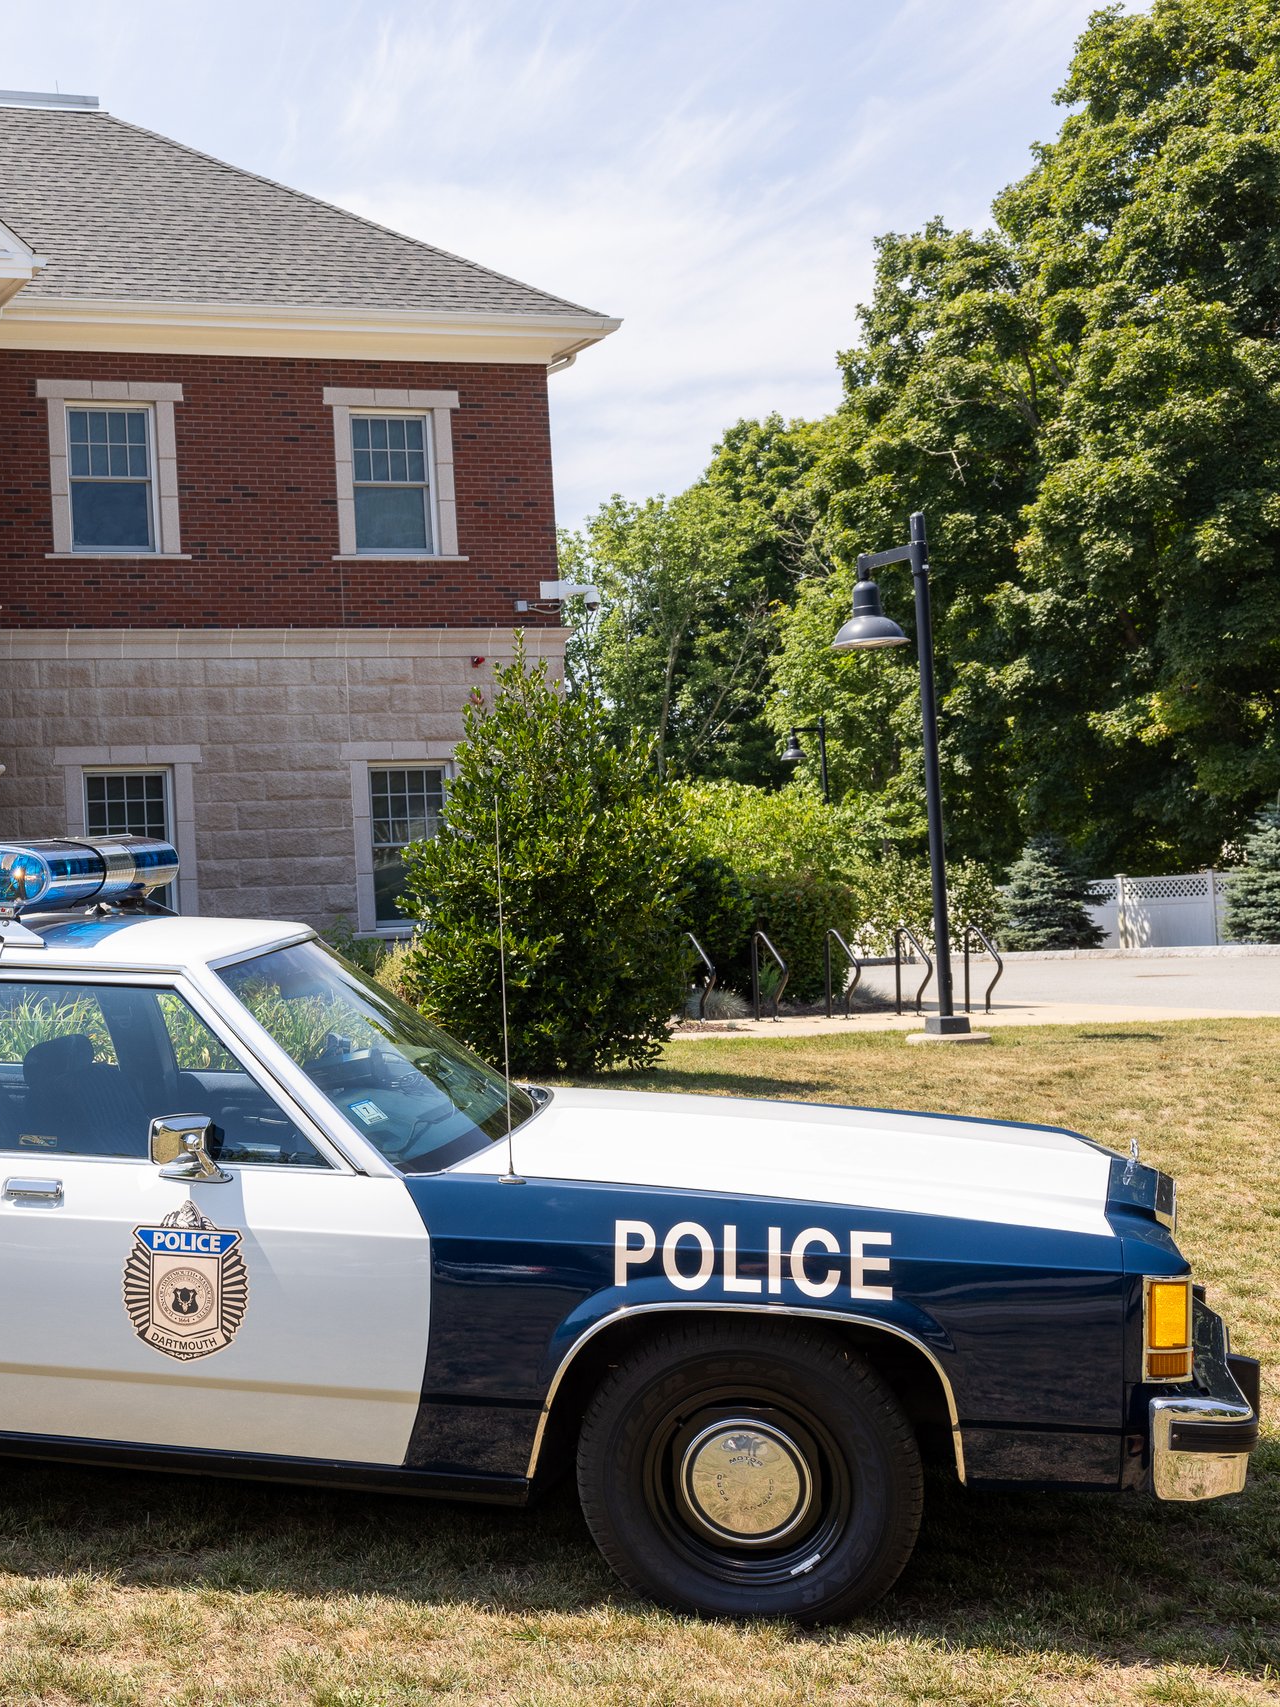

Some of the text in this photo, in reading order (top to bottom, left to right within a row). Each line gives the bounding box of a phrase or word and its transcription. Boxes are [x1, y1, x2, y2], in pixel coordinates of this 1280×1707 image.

[152, 1231, 221, 1253] POLICE
[614, 1219, 893, 1300] POLICE
[151, 1332, 217, 1351] DARTMOUTH
[728, 1455, 764, 1467] MOTOR
